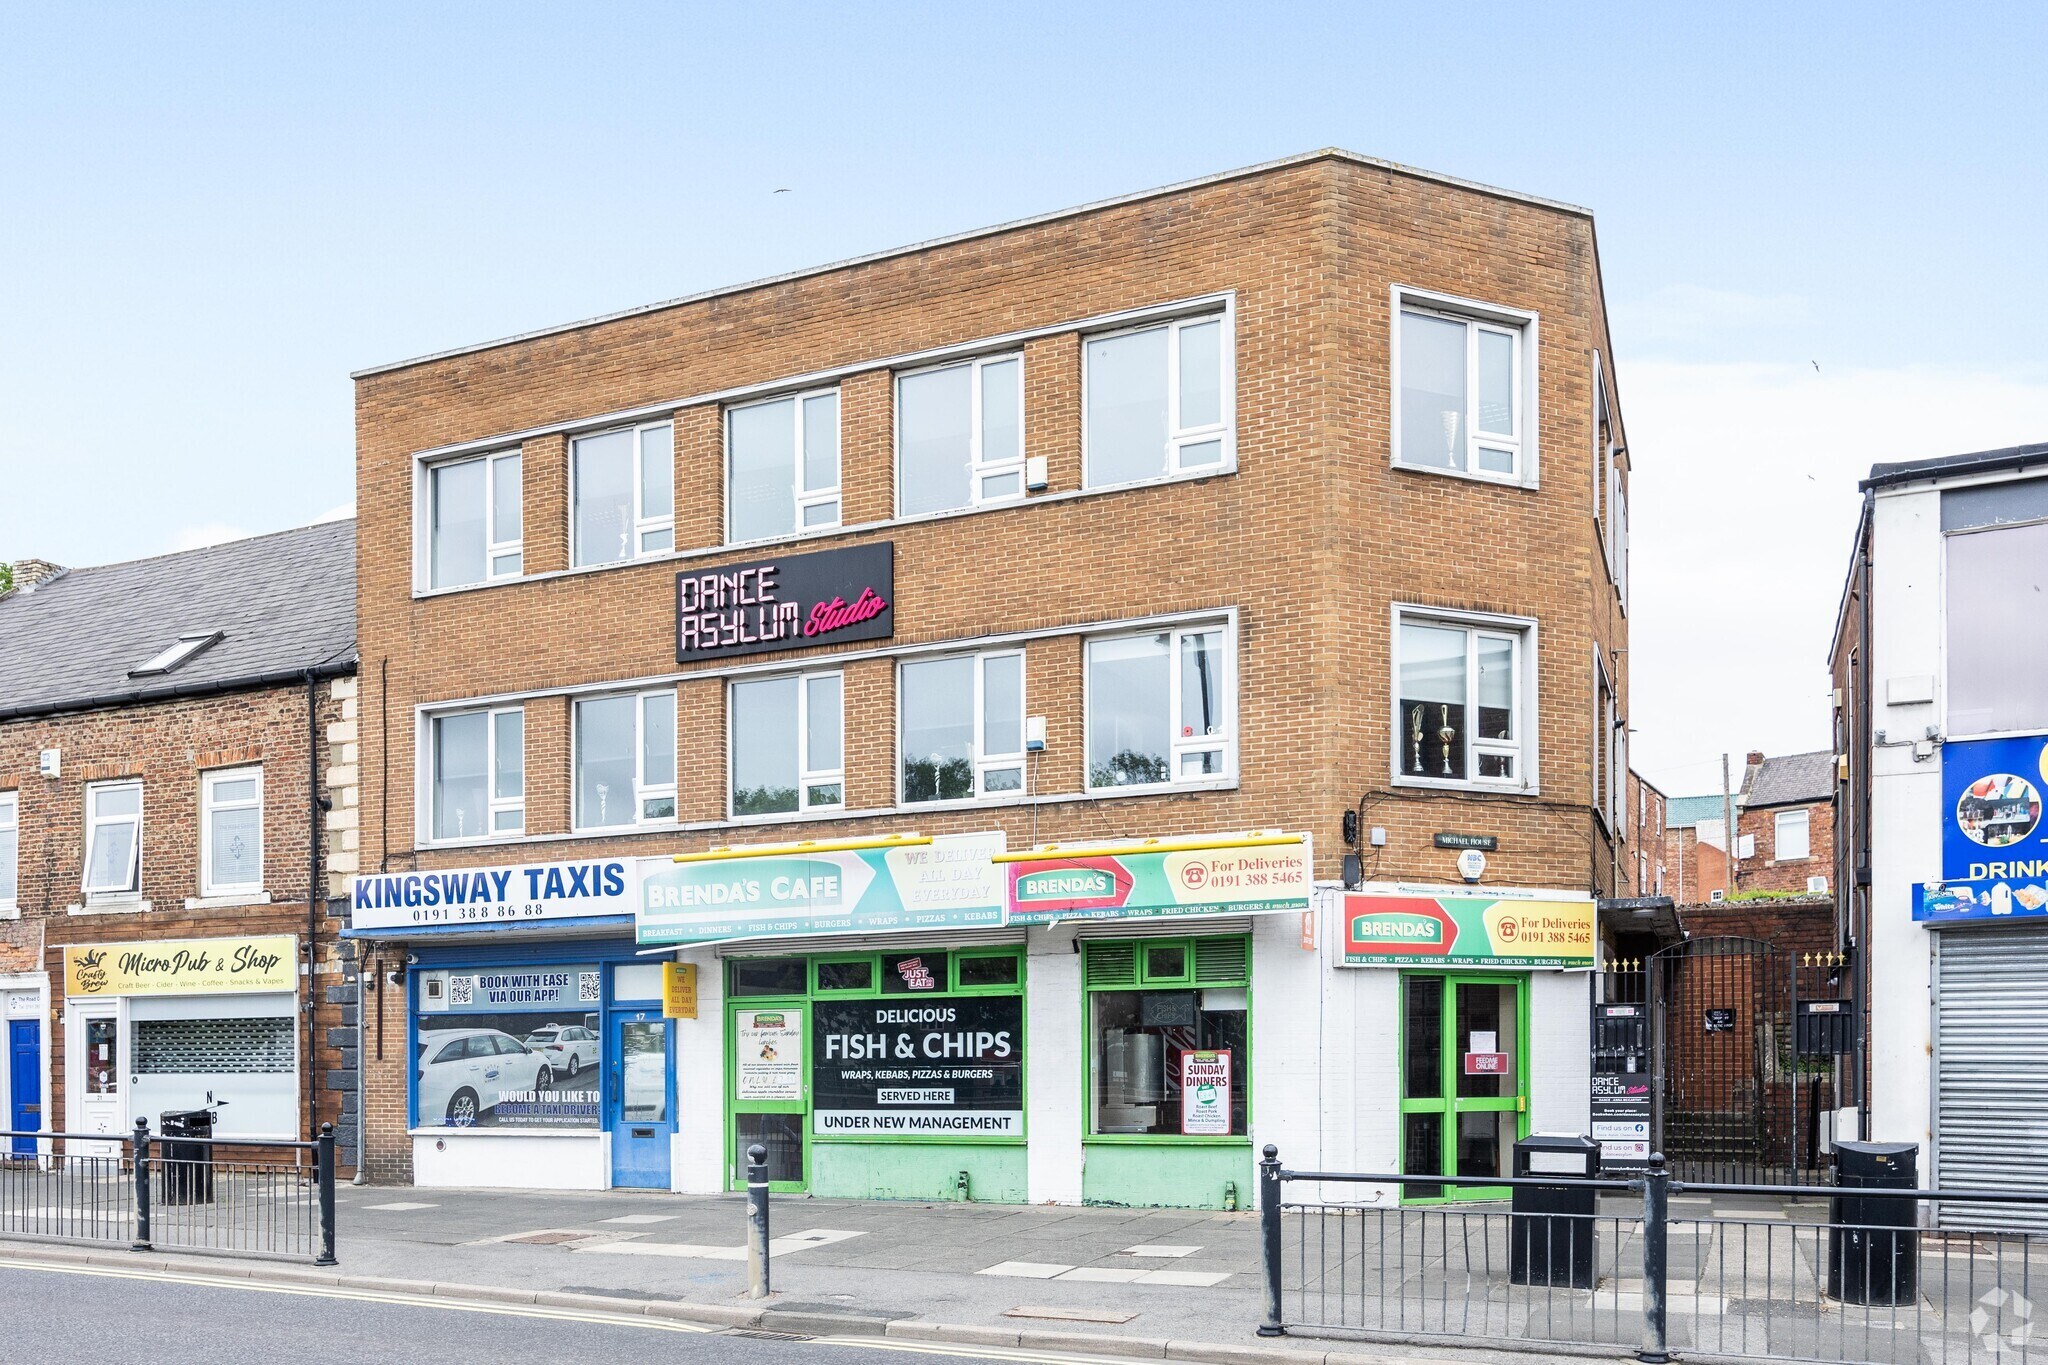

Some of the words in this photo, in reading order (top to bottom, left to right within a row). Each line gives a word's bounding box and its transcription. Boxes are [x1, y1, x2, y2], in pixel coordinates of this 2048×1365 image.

[681, 565, 776, 612] DANCE
[681, 601, 799, 650] ASYLUM
[803, 586, 888, 637] Studio
[1442, 837, 1469, 845] MICHAEL
[1470, 838, 1491, 846] HOUSE
[905, 852, 928, 864] WE
[934, 848, 996, 863] DELIVER
[1211, 860, 1234, 872] For
[1238, 856, 1303, 870] Deliveries
[919, 870, 945, 883] ALL
[953, 866, 983, 881] DAY
[1211, 875, 1240, 887] 0191
[1245, 873, 1268, 886] 388
[1272, 871, 1302, 884] 5465
[355, 870, 512, 909] KINGSWAY
[524, 863, 625, 900] TAXIS
[1026, 873, 1106, 895] BRENDA'S
[648, 878, 761, 908] BRENDA'S
[770, 876, 837, 900] CAFE
[912, 886, 991, 902] EVERYDAY
[413, 909, 449, 921] 0191
[459, 907, 488, 919] 388
[498, 905, 515, 917] 86
[525, 904, 543, 916] 88
[1033, 913, 1054, 921] CHIPS
[1091, 910, 1119, 918] KEBABS
[1128, 908, 1153, 916] WRAPS
[1161, 907, 1183, 915] FRIED
[1184, 905, 1219, 914] CHICKEN
[1228, 903, 1264, 911] BURGERS
[642, 928, 683, 937] BREAKFAST
[699, 926, 732, 934] DINNERS
[749, 923, 766, 931] FISH
[774, 922, 797, 930] CHIPS
[814, 919, 851, 928] BURGERS
[869, 916, 898, 925] WRAPS
[916, 915, 945, 923] PIZZAS
[964, 912, 998, 920] KEBABS
[1361, 919, 1435, 937] BRENDA'S
[1521, 917, 1539, 928] For
[1543, 917, 1591, 929] Deliveries
[1521, 932, 1544, 942] 0191
[1548, 932, 1565, 943] 388
[1567, 933, 1591, 943] 5465
[215, 958, 224, 971] &
[231, 945, 282, 974] Shop
[76, 969, 106, 980] Crafty
[905, 969, 927, 978] JUST
[80, 979, 108, 990] Brew
[230, 978, 254, 986] Snacks
[263, 977, 284, 985] Vapes
[479, 976, 509, 989] BOOK
[511, 975, 541, 988] WITH
[543, 973, 569, 986] EASE
[910, 979, 927, 987] EAT
[489, 991, 507, 1003] VIA
[509, 990, 531, 1002] OUR
[534, 989, 559, 1002] APP!
[671, 986, 692, 994] DELIVER
[635, 1013, 645, 1021] 17
[669, 1006, 696, 1014] EVERYDAY
[876, 1008, 956, 1024] DELICIOUS
[825, 1033, 887, 1059] FISH
[894, 1032, 916, 1059] &
[922, 1031, 1011, 1059] CHIPS
[841, 1069, 874, 1081] WRAPS,
[875, 1069, 910, 1080] KEBABS,
[912, 1068, 943, 1080] PIZZAS
[943, 1069, 951, 1079] &
[951, 1069, 993, 1080] BURGERS
[1188, 1065, 1225, 1075] SUNDAY
[1186, 1076, 1227, 1087] DINNERS
[1592, 1077, 1619, 1086] DANCE
[498, 1090, 536, 1103] WOULD
[538, 1090, 559, 1102] YOU
[562, 1090, 584, 1103] LIKE
[586, 1091, 600, 1103] TO
[881, 1090, 921, 1102] SERVED
[923, 1090, 951, 1101] HERE
[1592, 1086, 1626, 1094] ASYLUM
[495, 1104, 531, 1115] BECOME
[533, 1104, 540, 1115] A
[542, 1104, 561, 1115] TAXI
[824, 1116, 870, 1130] UNDER
[873, 1116, 906, 1130] NEW
[909, 1116, 1011, 1130] MANAGEMENT
